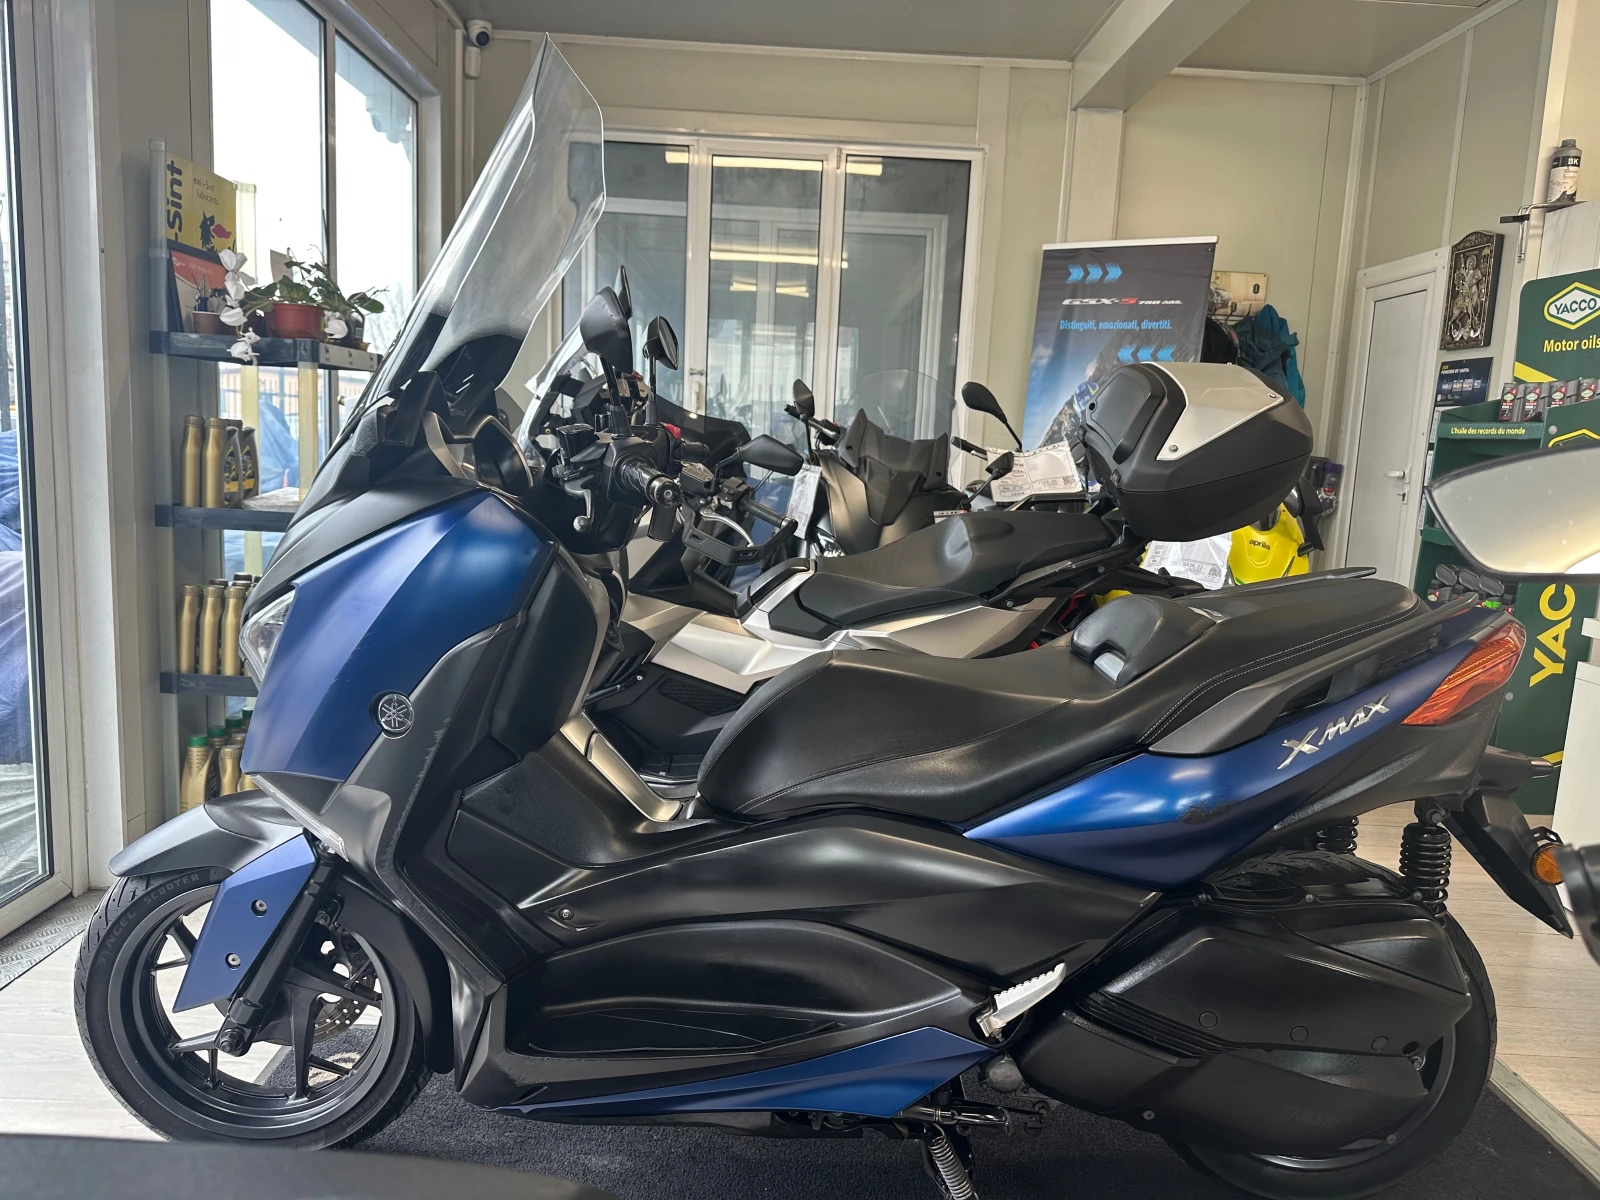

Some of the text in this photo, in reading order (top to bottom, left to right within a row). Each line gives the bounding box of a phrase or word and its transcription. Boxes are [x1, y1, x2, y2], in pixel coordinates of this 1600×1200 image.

[1554, 297, 1597, 315] YACCO
[1060, 320, 1172, 331] Distinguiti, emozionati, divertiti.
[1543, 334, 1600, 353] Motor oils
[1450, 426, 1526, 435] L'huile des records du monde
[1248, 538, 1271, 551] aprilia
[143, 873, 200, 905] SCOOTER
